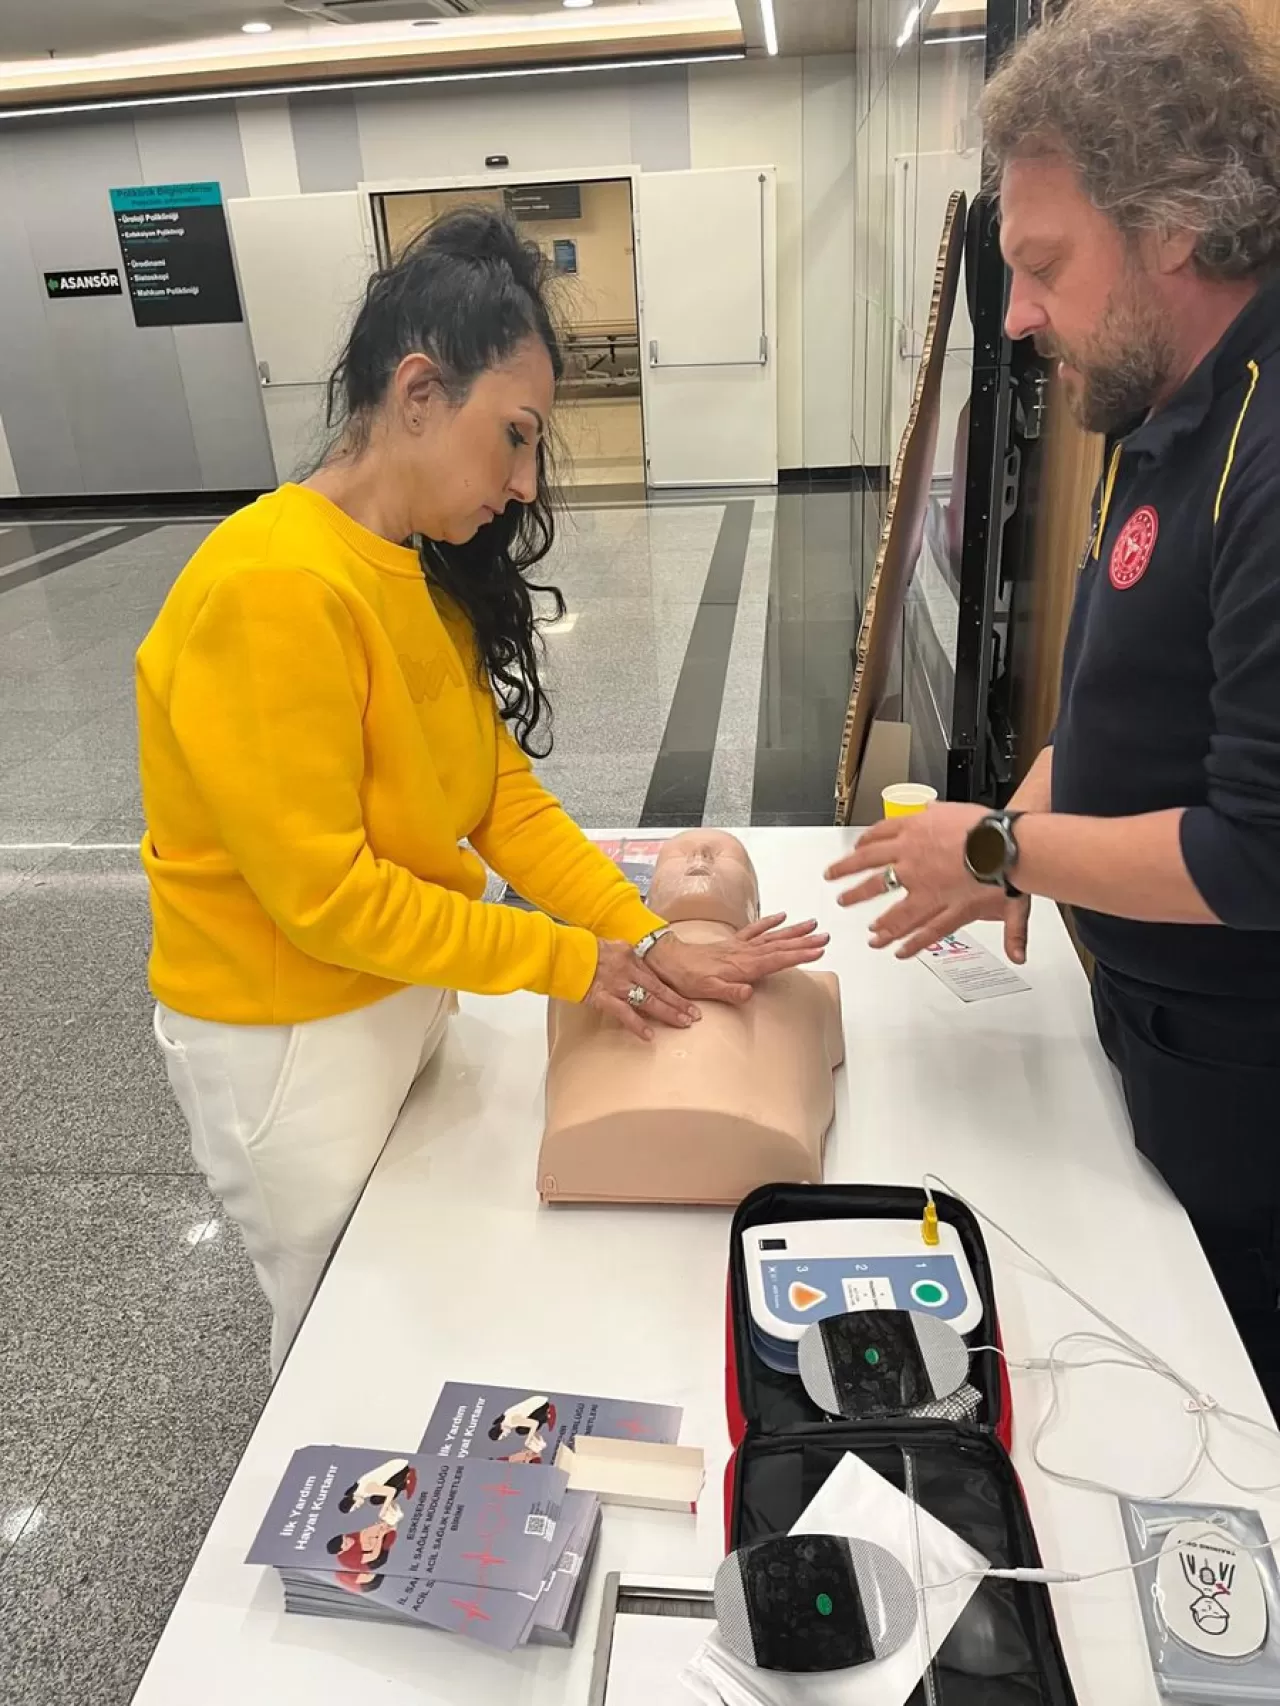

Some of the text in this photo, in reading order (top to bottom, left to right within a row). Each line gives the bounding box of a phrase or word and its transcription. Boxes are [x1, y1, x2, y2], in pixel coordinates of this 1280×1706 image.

[60, 272, 119, 290] ASANSÖR
[137, 288, 165, 296] Mahkum
[855, 1263, 868, 1271] 2
[437, 1405, 468, 1457] İlk Yardım
[464, 1396, 486, 1437] Kurtarır
[279, 1475, 317, 1537] İlk Yardım
[294, 1464, 338, 1551] Hayat Kurtarır
[425, 1465, 449, 1521] MÜDÜRLÜĞÜ
[407, 1491, 428, 1540] ESKİŞEHİR
[426, 1552, 438, 1573] ACİL
[432, 1516, 449, 1550] SAĞLIK
[444, 1465, 465, 1514] HİZMETLERİ
[413, 1524, 431, 1559] SAĞLIK
[1199, 1543, 1236, 1556] TRAINING
[408, 1562, 419, 1572] İL
[396, 1596, 408, 1605] İL
[412, 1590, 430, 1612] ACİL
